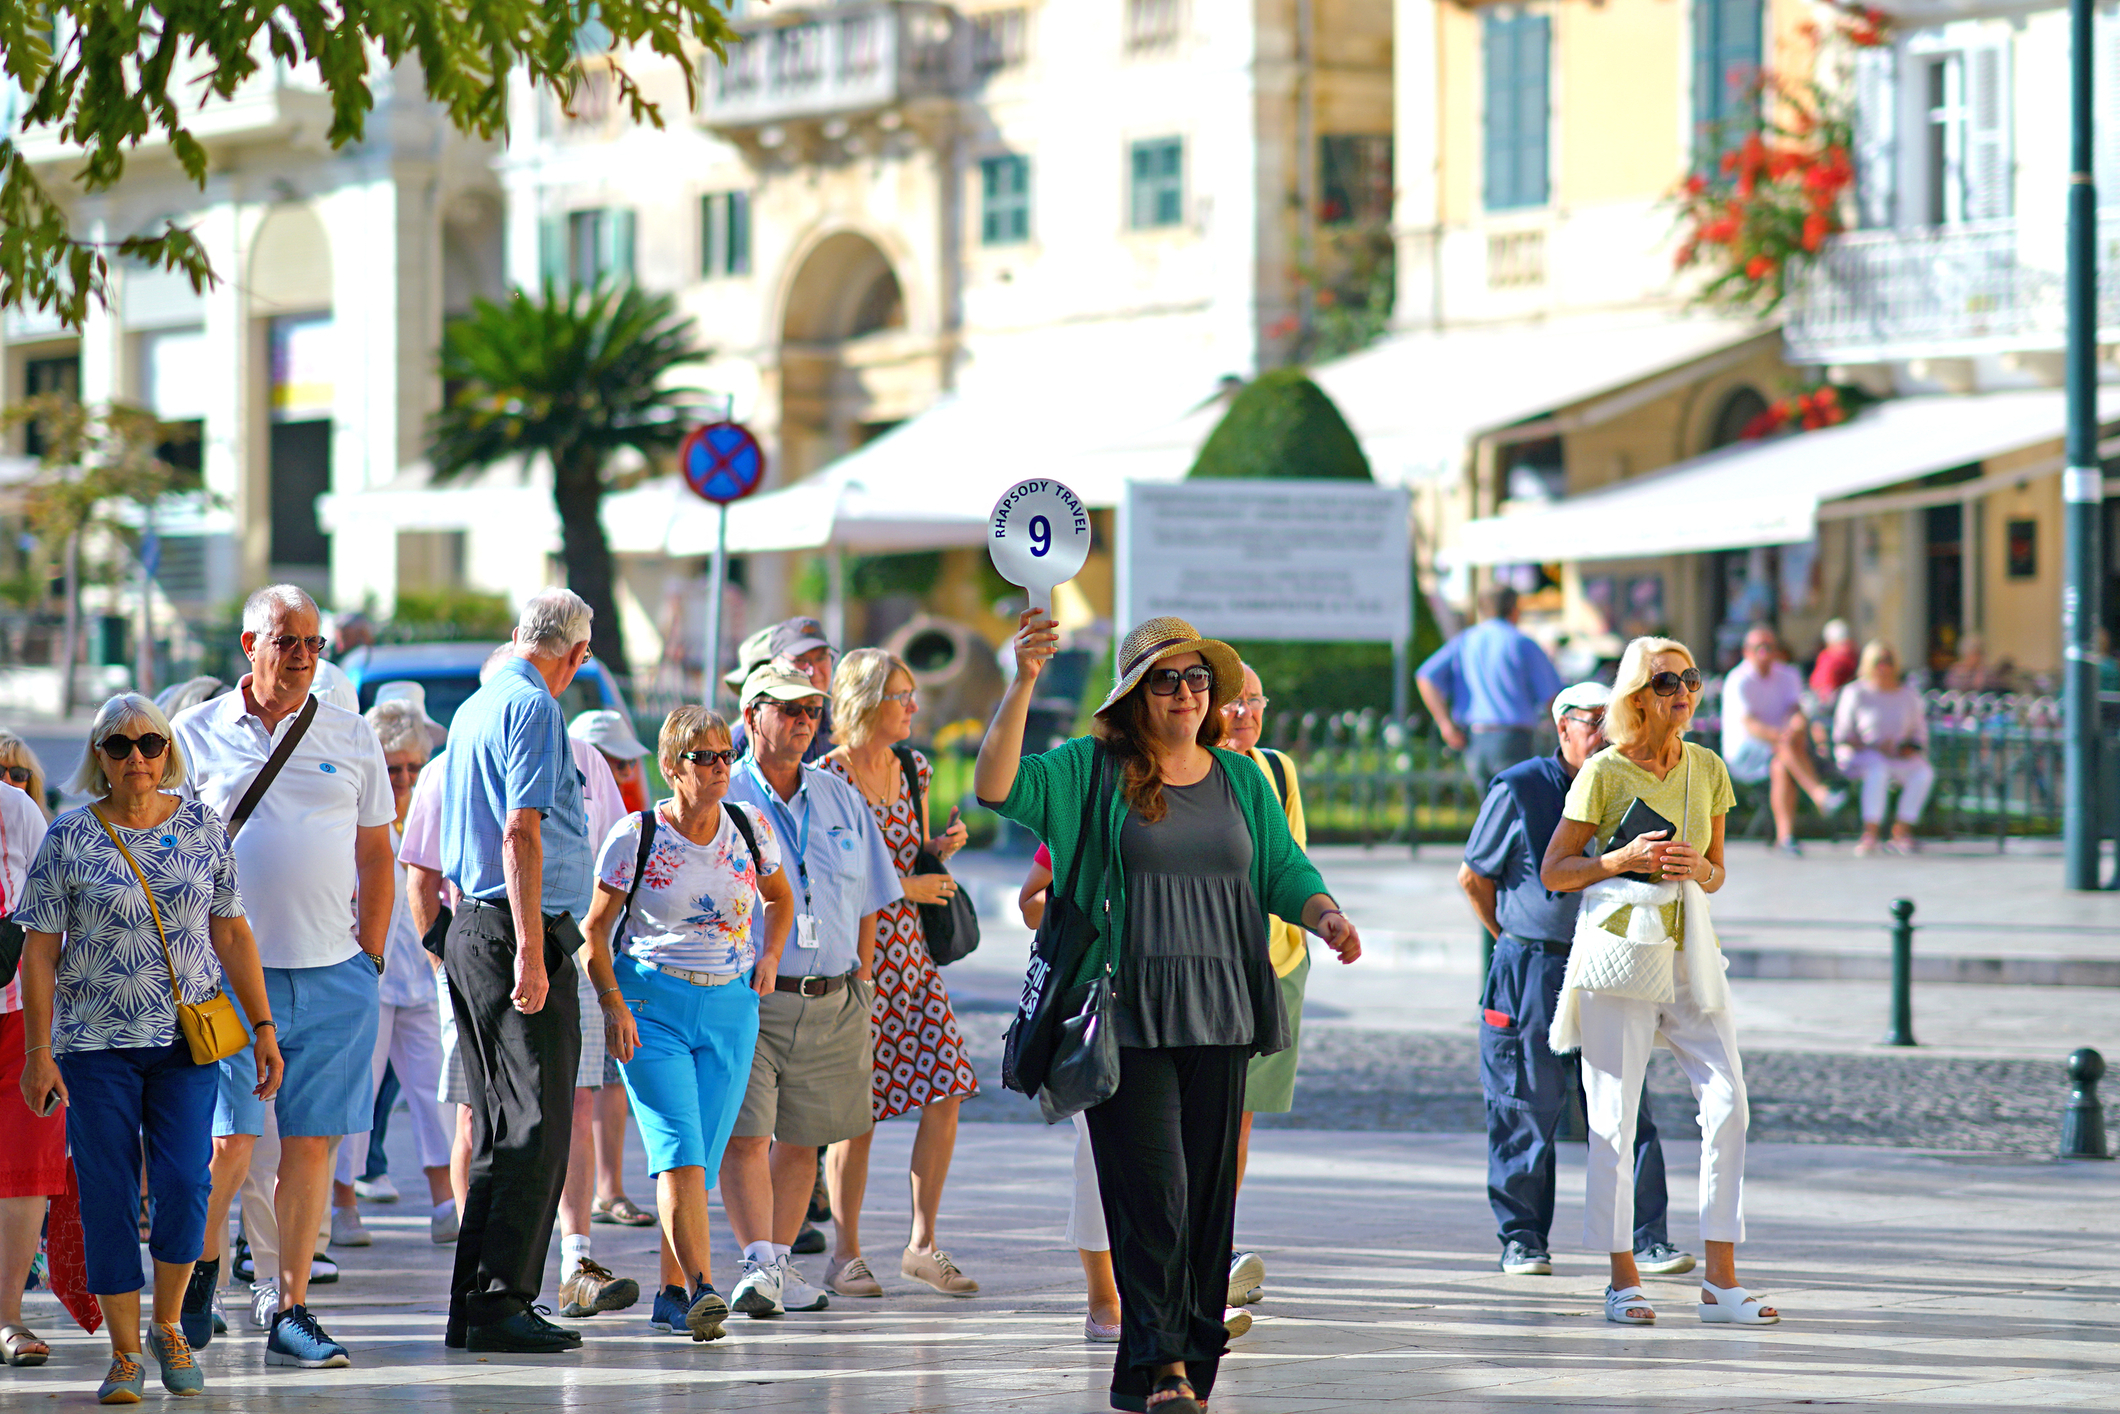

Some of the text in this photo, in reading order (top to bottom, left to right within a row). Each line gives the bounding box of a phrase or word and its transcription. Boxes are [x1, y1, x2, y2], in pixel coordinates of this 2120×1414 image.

[995, 481, 1086, 538] RHAPSODY TRAVEL
[1028, 514, 1052, 558] 9
[324, 764, 331, 772] 9
[164, 837, 172, 847] 9
[737, 862, 744, 870] 9
